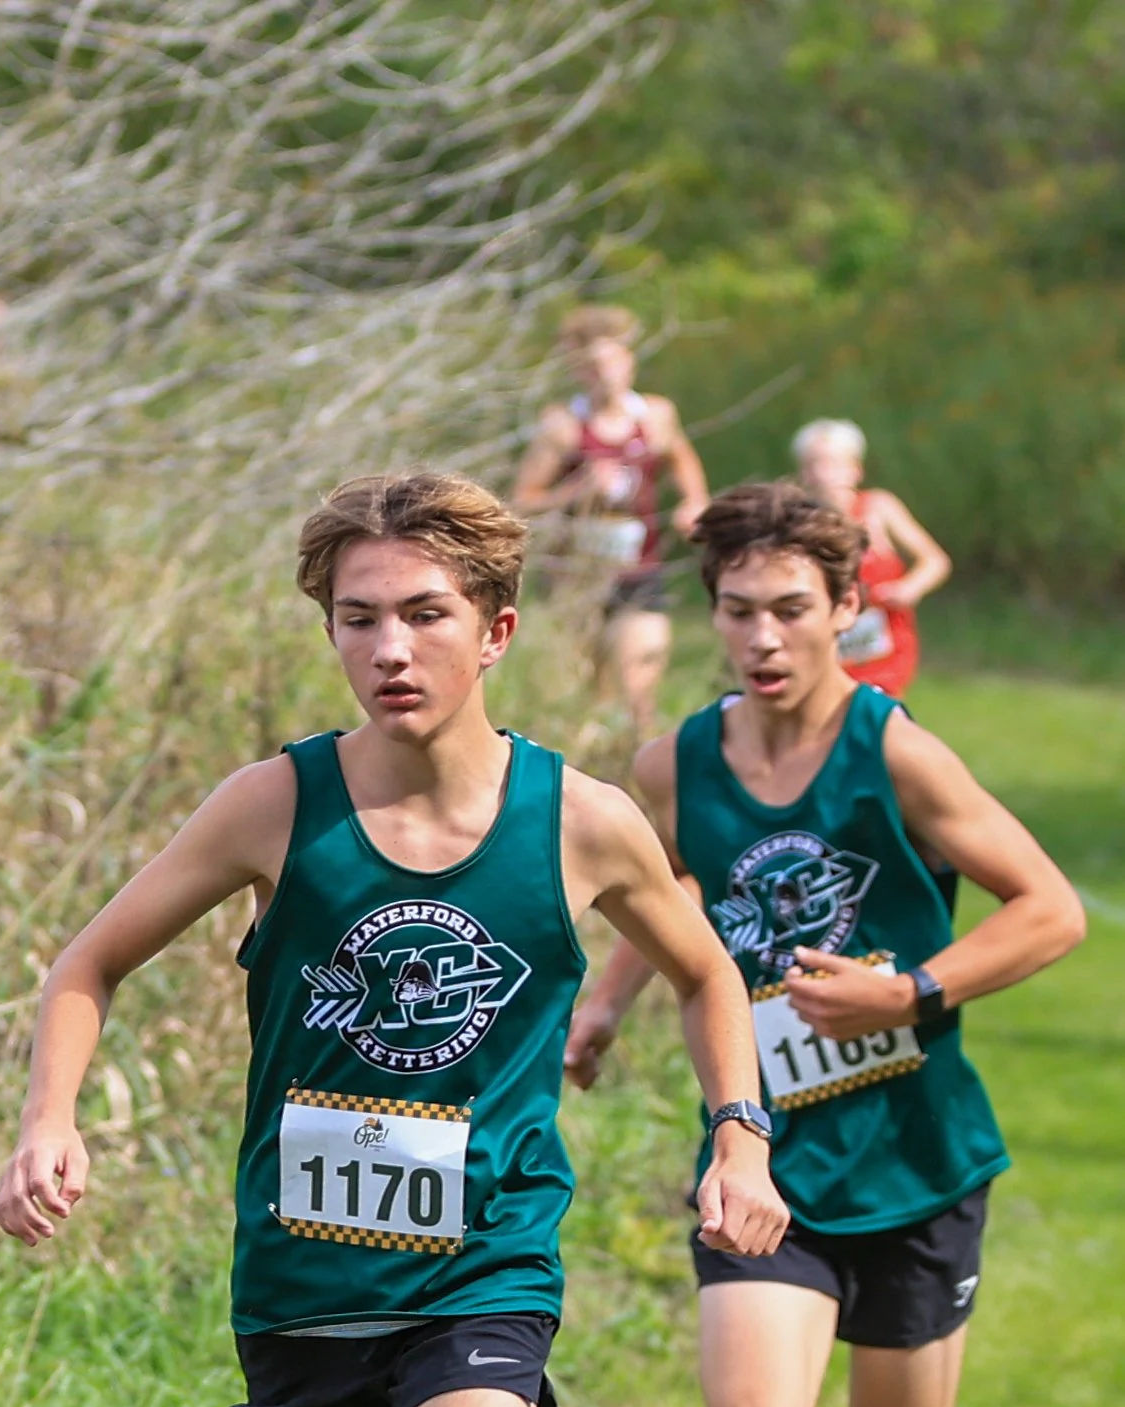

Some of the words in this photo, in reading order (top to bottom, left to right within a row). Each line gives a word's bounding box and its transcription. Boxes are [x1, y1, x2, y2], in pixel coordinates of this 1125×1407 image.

[343, 905, 478, 954] WATERFORD
[348, 941, 478, 1032] XC
[354, 1011, 489, 1069] KETTERING
[354, 1126, 390, 1148] Ope!
[300, 1155, 443, 1227] 1170
